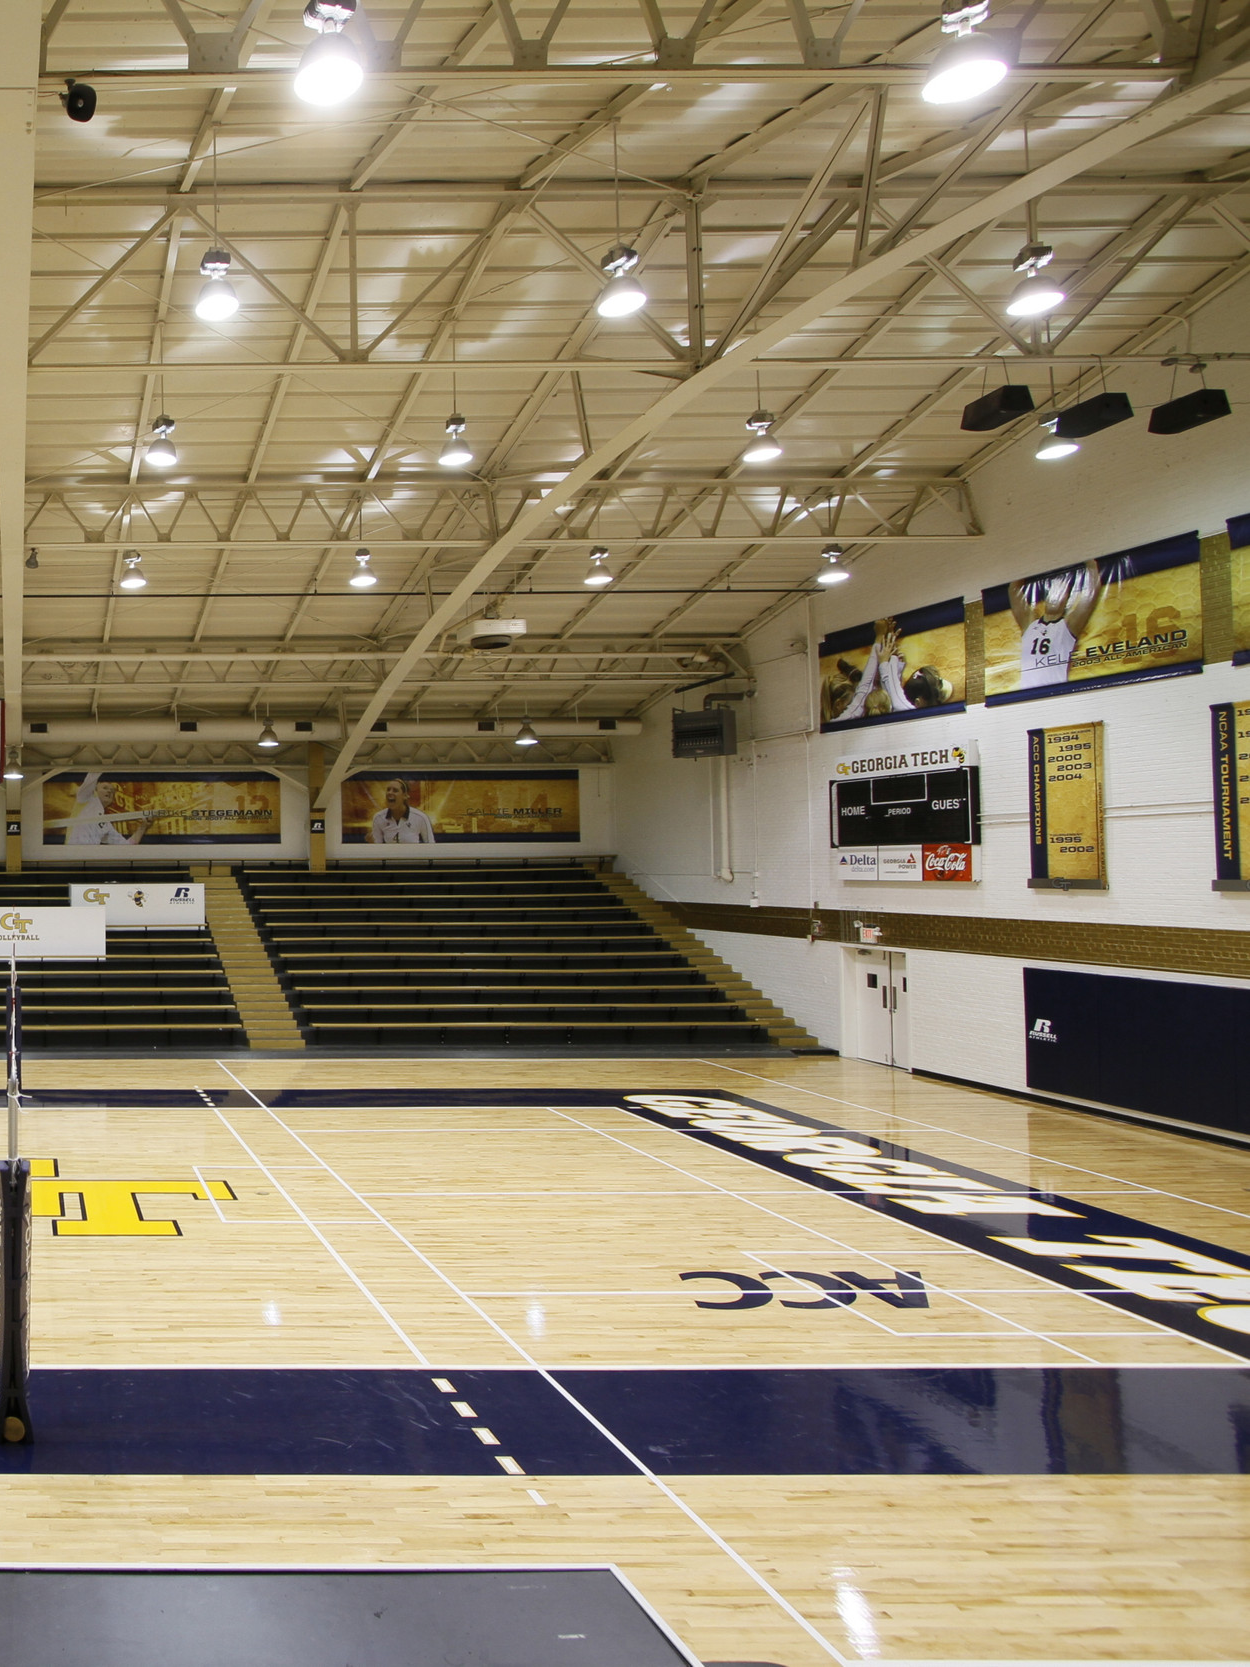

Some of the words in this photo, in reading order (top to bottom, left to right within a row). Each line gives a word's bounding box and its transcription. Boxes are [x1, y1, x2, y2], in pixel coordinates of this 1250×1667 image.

[1030, 637, 1051, 655] 16
[1086, 629, 1188, 658] EVELAND
[1072, 658, 1102, 668] 2003
[1104, 642, 1188, 662] ALL-AMERICAN
[1218, 711, 1228, 751] NCAA
[1047, 734, 1079, 744] 1994
[1032, 736, 1040, 761] ACC
[1058, 742, 1092, 752] 1995
[851, 754, 909, 774] GEORGIA
[911, 749, 949, 767] TECH
[1047, 753, 1082, 763] 2000
[1056, 762, 1092, 772] 2003
[1048, 773, 1082, 782] 2004
[931, 798, 967, 810] GUES
[1033, 764, 1042, 845] CHAMPIONS
[1220, 754, 1232, 860] TOURNAMENT
[142, 809, 188, 817] ULRIKE
[190, 809, 273, 817] STEGEMANN
[512, 807, 563, 815] MILLER
[841, 806, 866, 816] HOME
[887, 807, 912, 815] PERIOD
[1049, 836, 1082, 844] 1995
[1059, 845, 1095, 853] 2002
[849, 854, 877, 866] Delta
[623, 1094, 1087, 1217] GEORGIA
[678, 1271, 930, 1310] ACC
